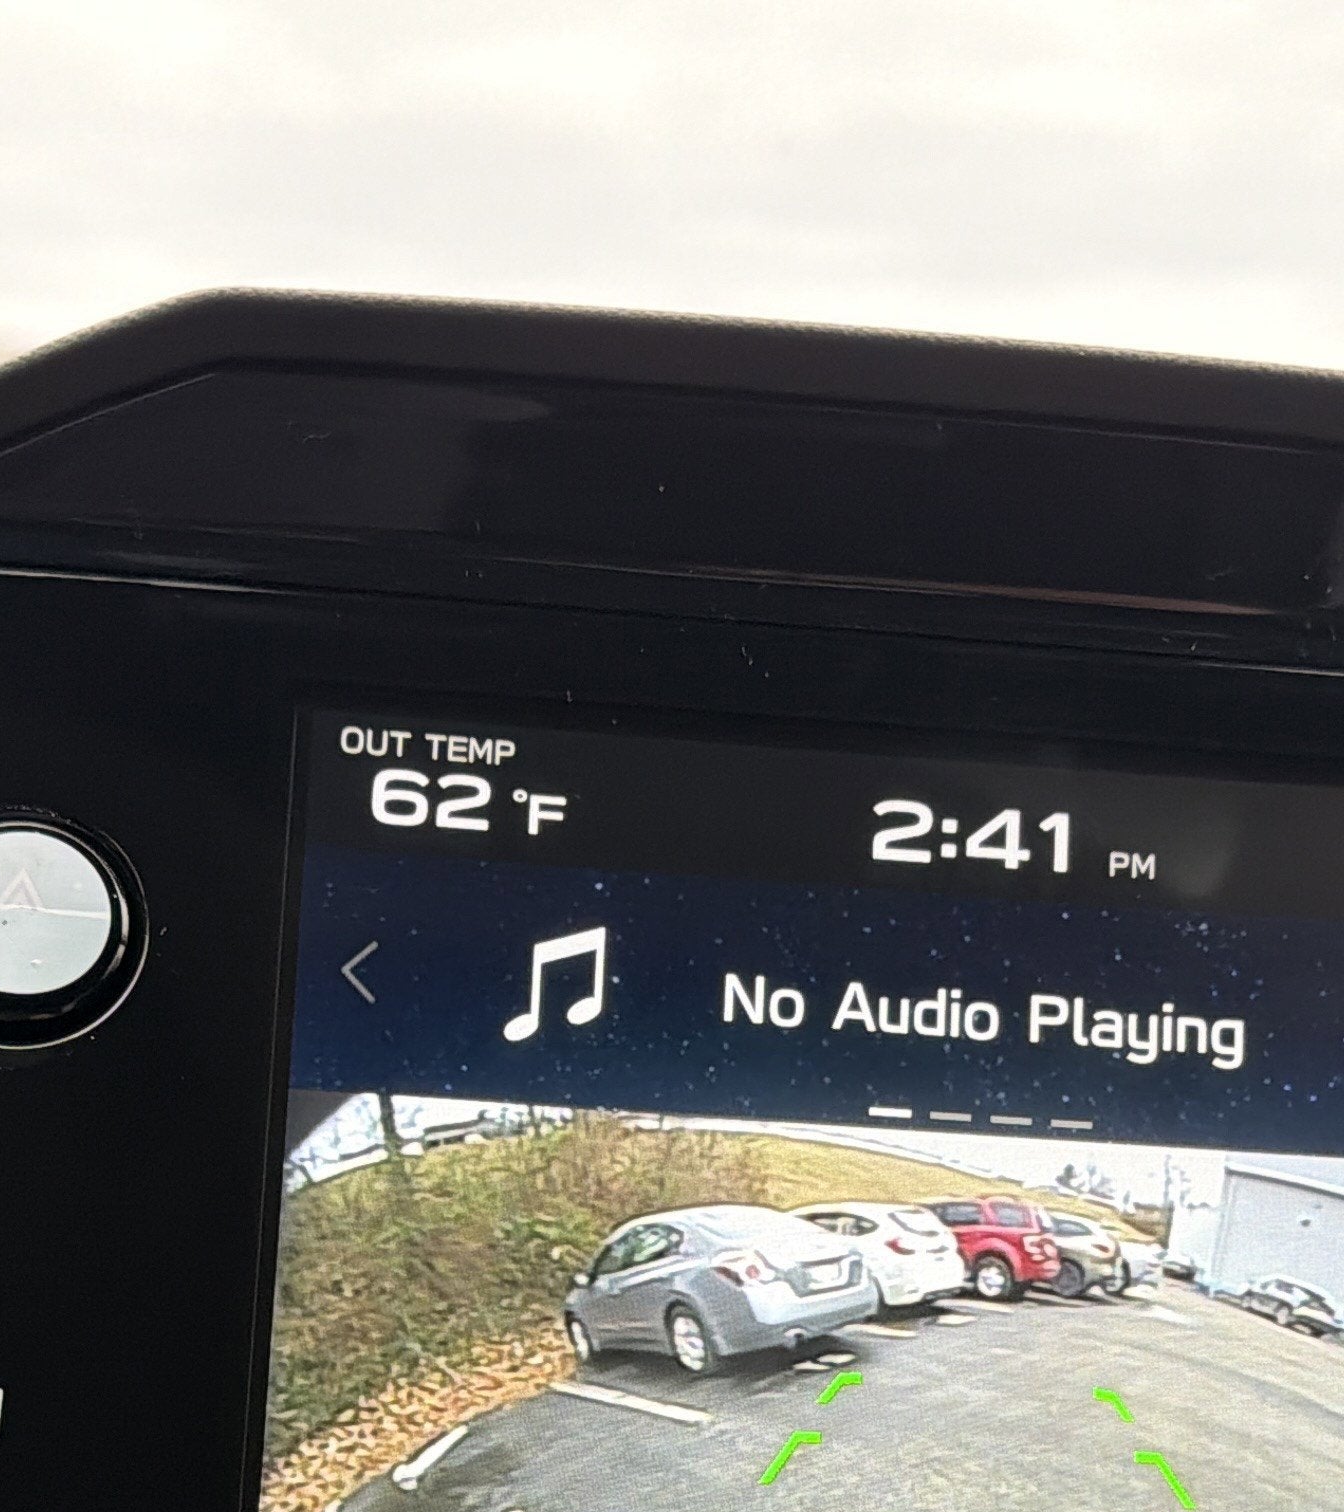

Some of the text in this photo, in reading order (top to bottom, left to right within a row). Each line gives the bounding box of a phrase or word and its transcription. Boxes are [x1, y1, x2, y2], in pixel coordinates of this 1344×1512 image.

[340, 725, 516, 766] OUT TEMP
[370, 767, 492, 832] 62
[871, 799, 1157, 880] 2:41 PM
[723, 973, 1246, 1070] No Audio Playing
